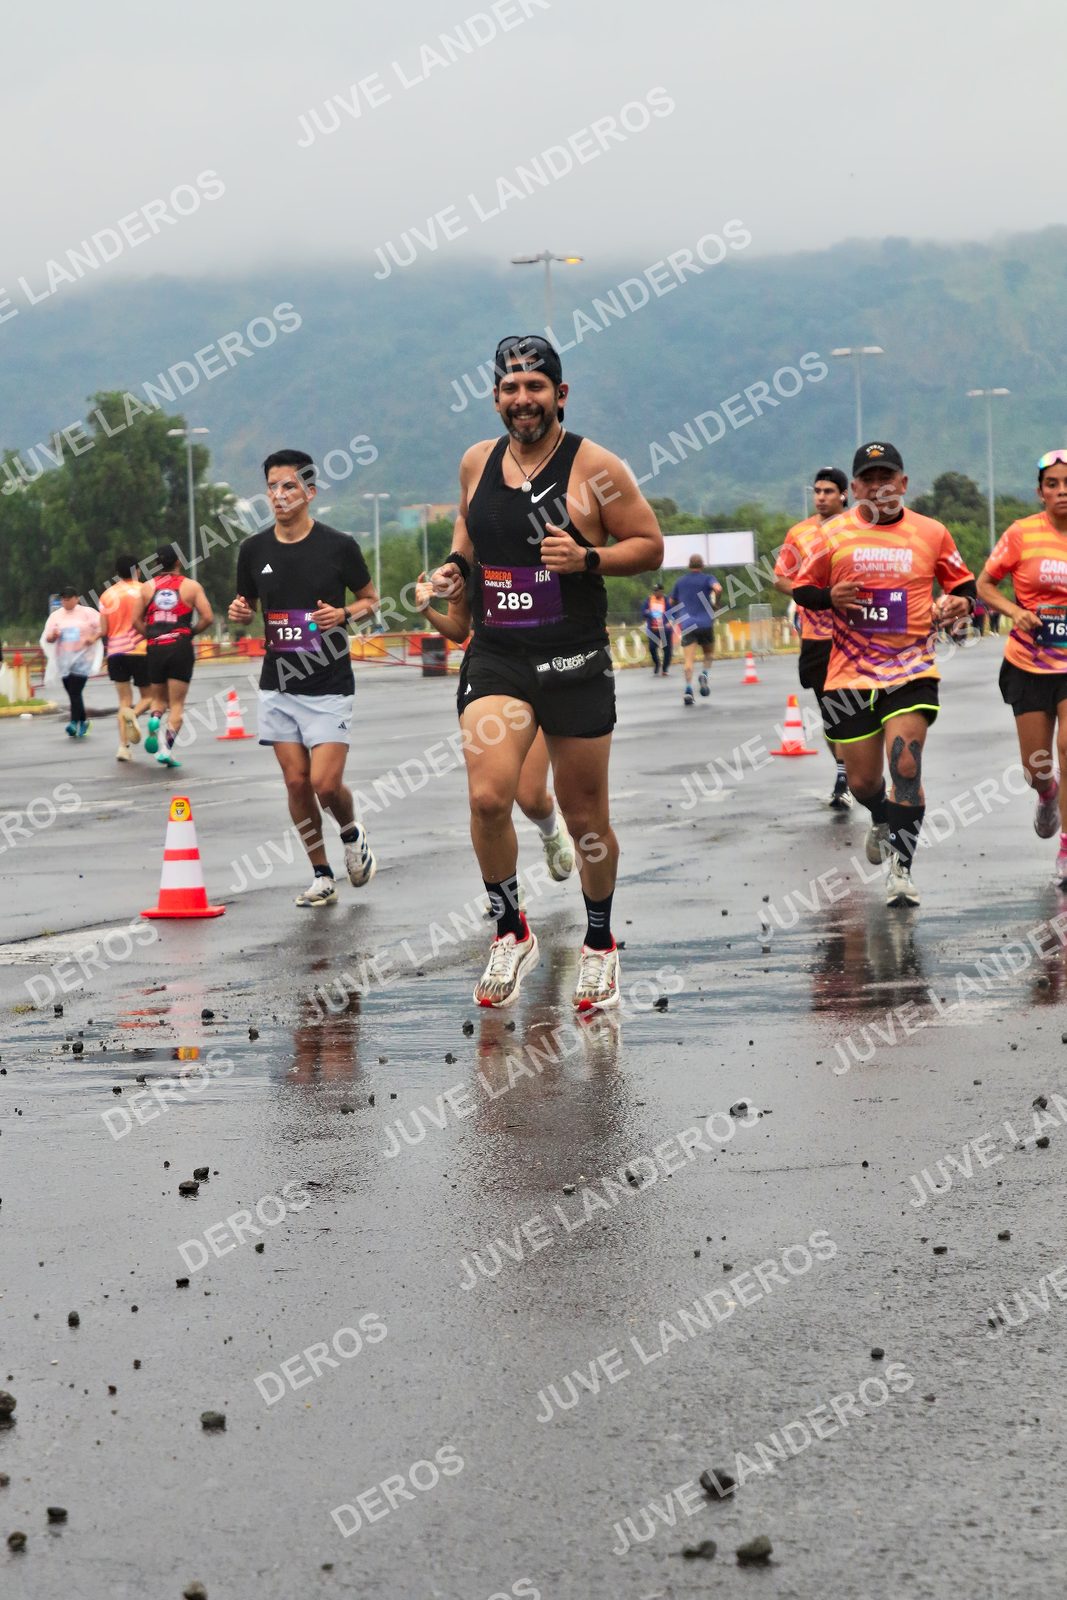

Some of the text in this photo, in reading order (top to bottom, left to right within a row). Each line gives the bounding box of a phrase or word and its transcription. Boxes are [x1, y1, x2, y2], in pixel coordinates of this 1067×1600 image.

[853, 547, 913, 562] CARRERA
[496, 592, 533, 610] 289
[861, 606, 888, 620] 143
[277, 627, 302, 640] 132
[1048, 622, 1067, 636] 16
